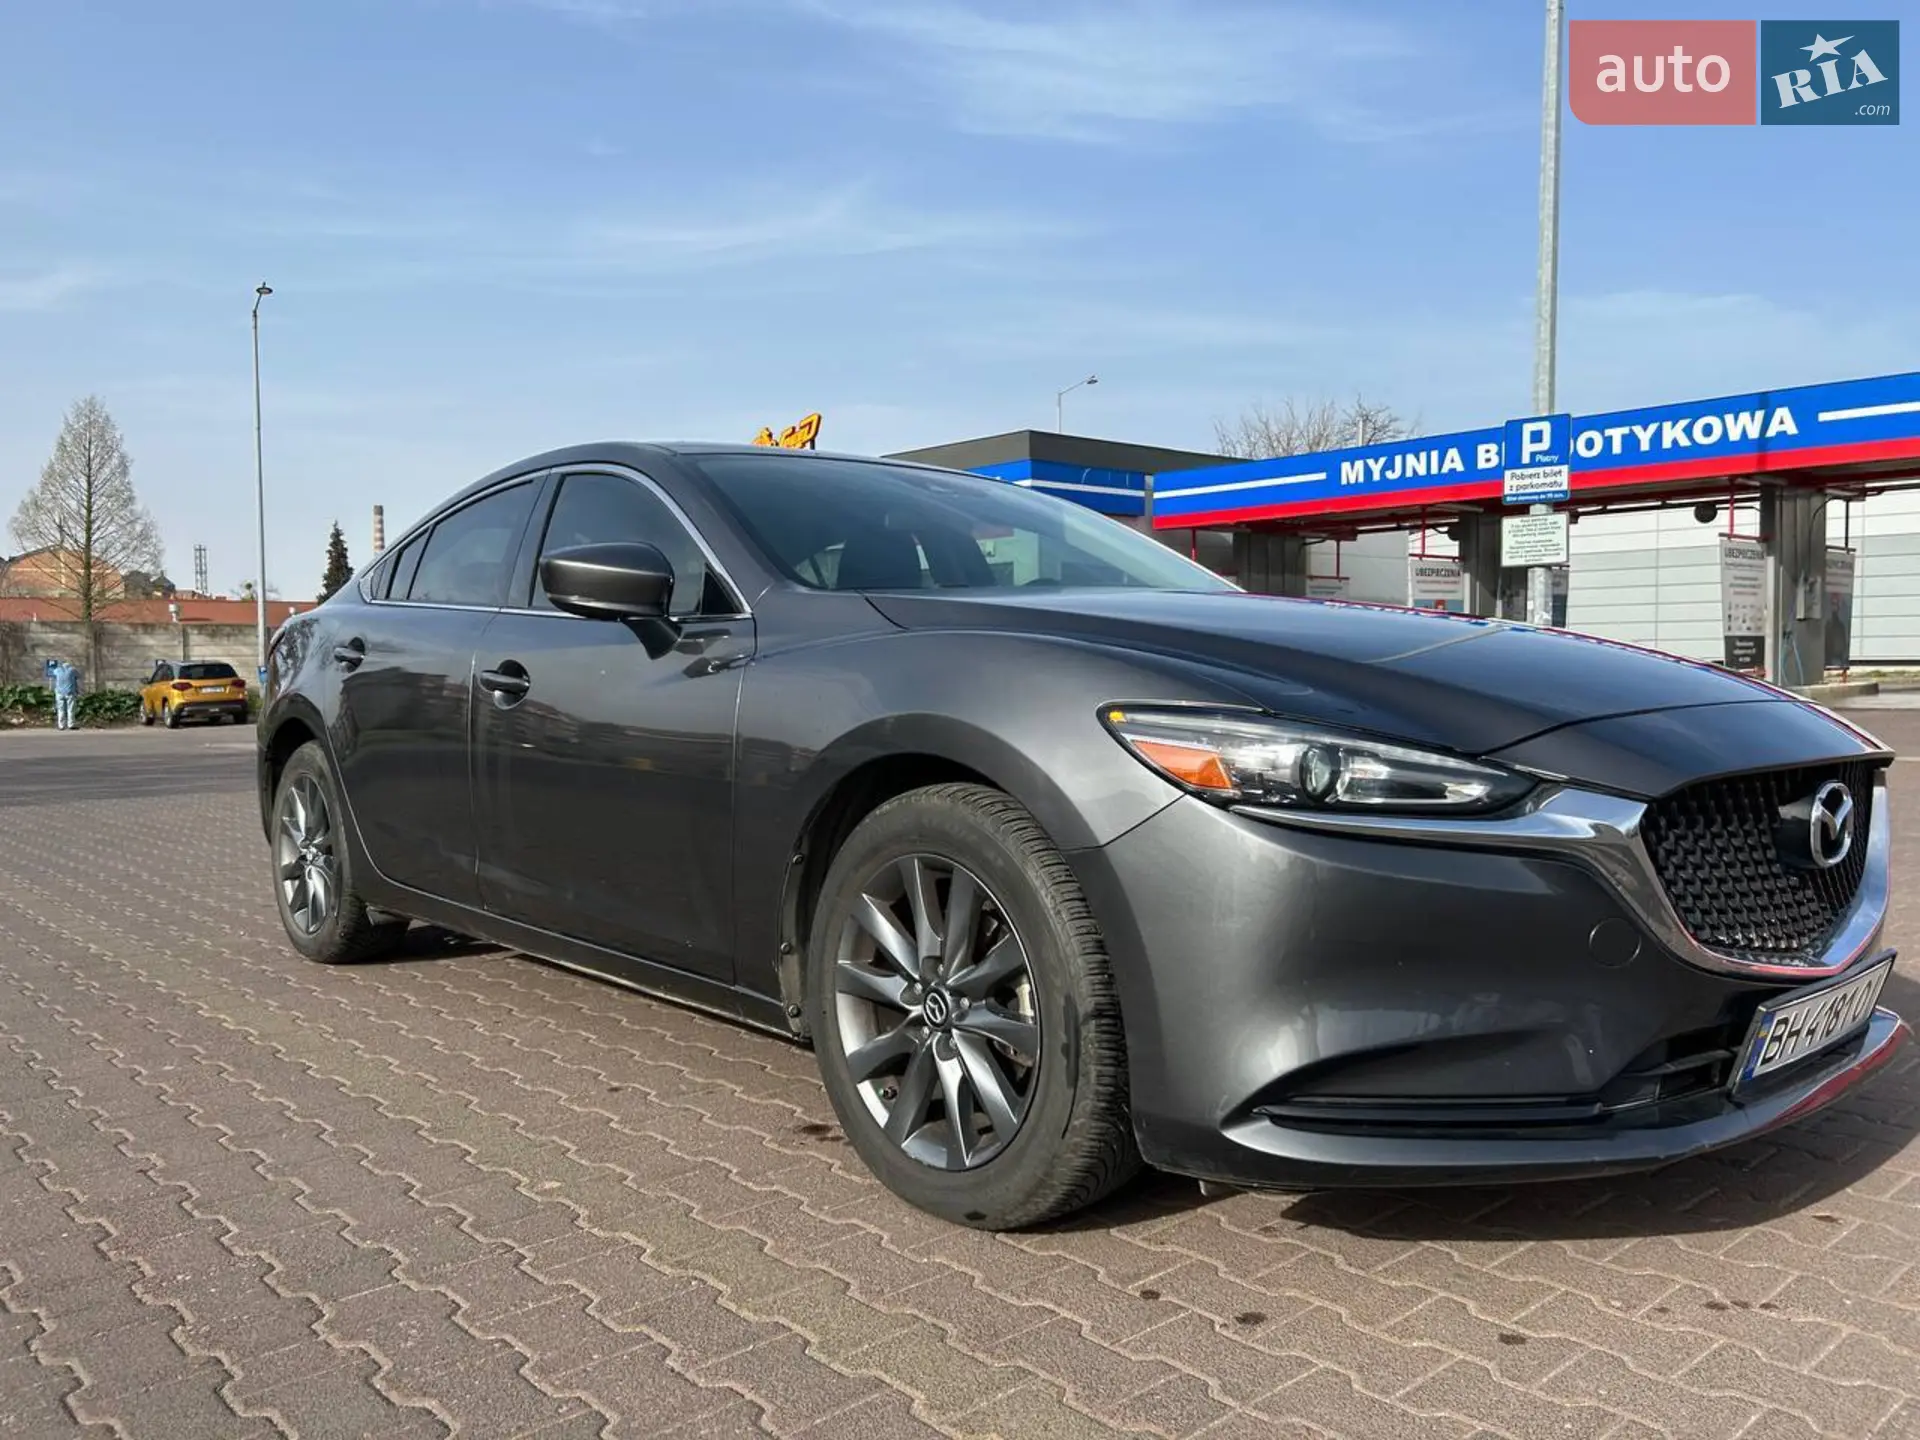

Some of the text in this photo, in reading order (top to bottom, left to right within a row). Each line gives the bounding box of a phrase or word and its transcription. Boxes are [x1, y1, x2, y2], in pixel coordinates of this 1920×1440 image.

[1340, 405, 1799, 486] MYJNIA BOTYKOWA
[1521, 421, 1552, 465] P
[1510, 469, 1563, 481] Pobierz bilet
[1515, 481, 1564, 492] parkomatu
[1759, 1006, 1811, 1067] BH
